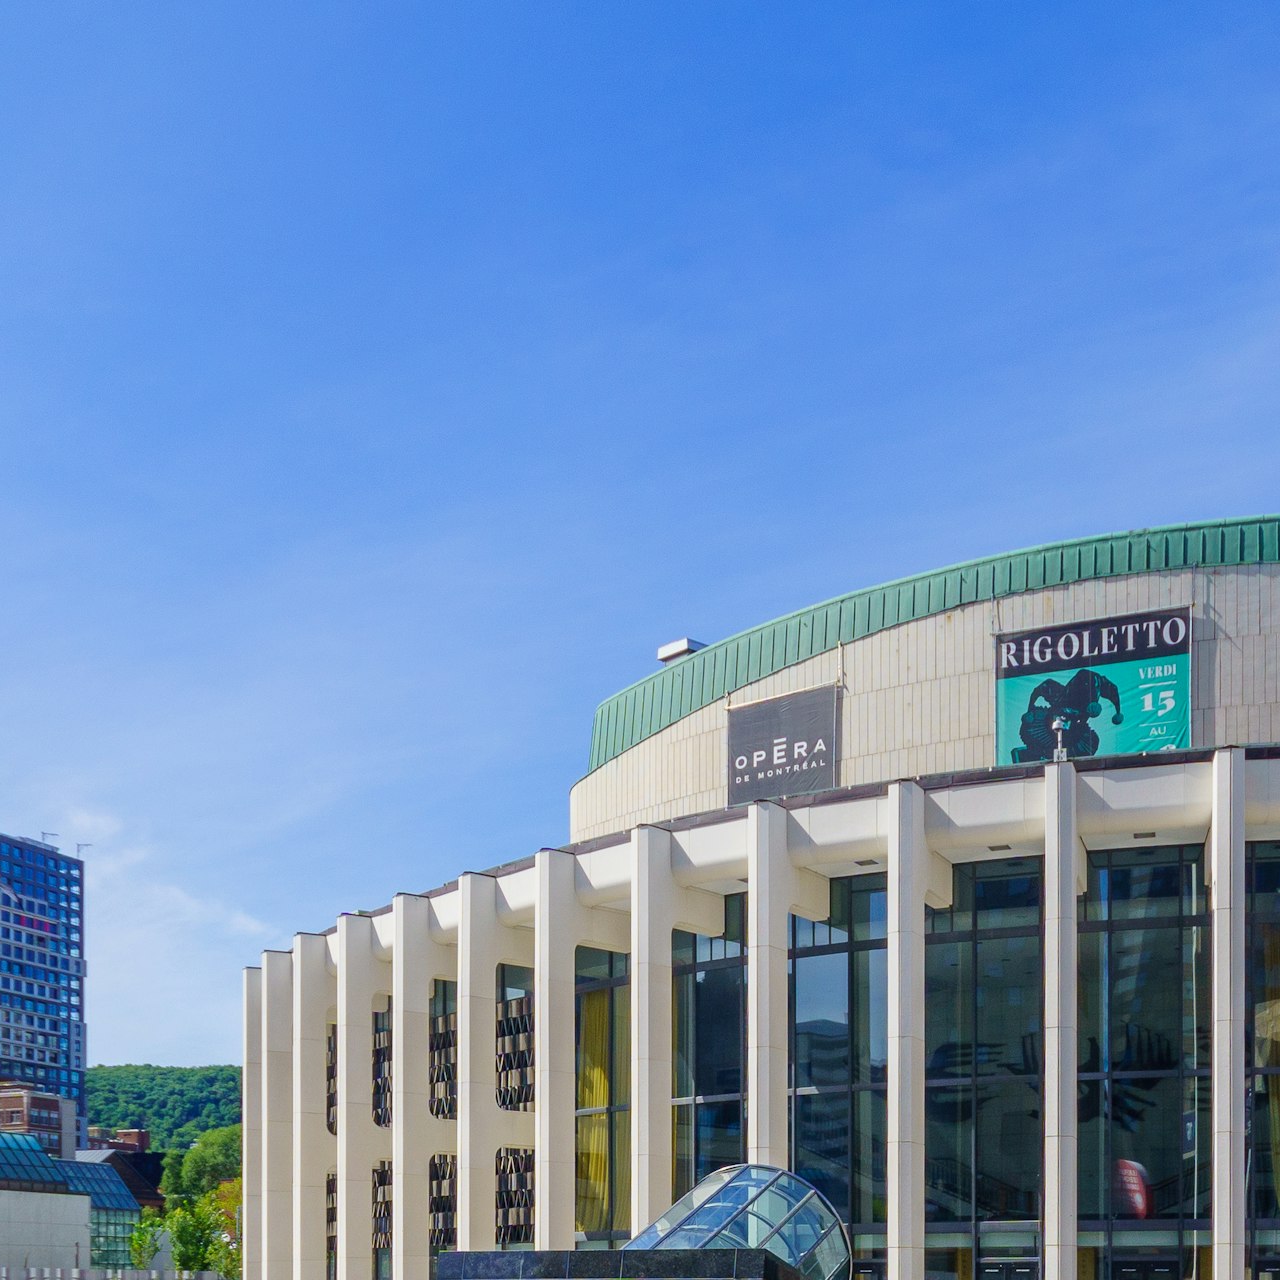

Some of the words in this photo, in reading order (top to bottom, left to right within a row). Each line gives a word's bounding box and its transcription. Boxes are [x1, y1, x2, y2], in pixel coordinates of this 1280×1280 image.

[1001, 617, 1186, 669] RIGOLETTO
[1139, 664, 1177, 680] VERDI
[1140, 690, 1176, 717] 15
[1149, 726, 1167, 736] AU
[735, 774, 749, 784] DE
[758, 759, 826, 779] MONTRÉAL
